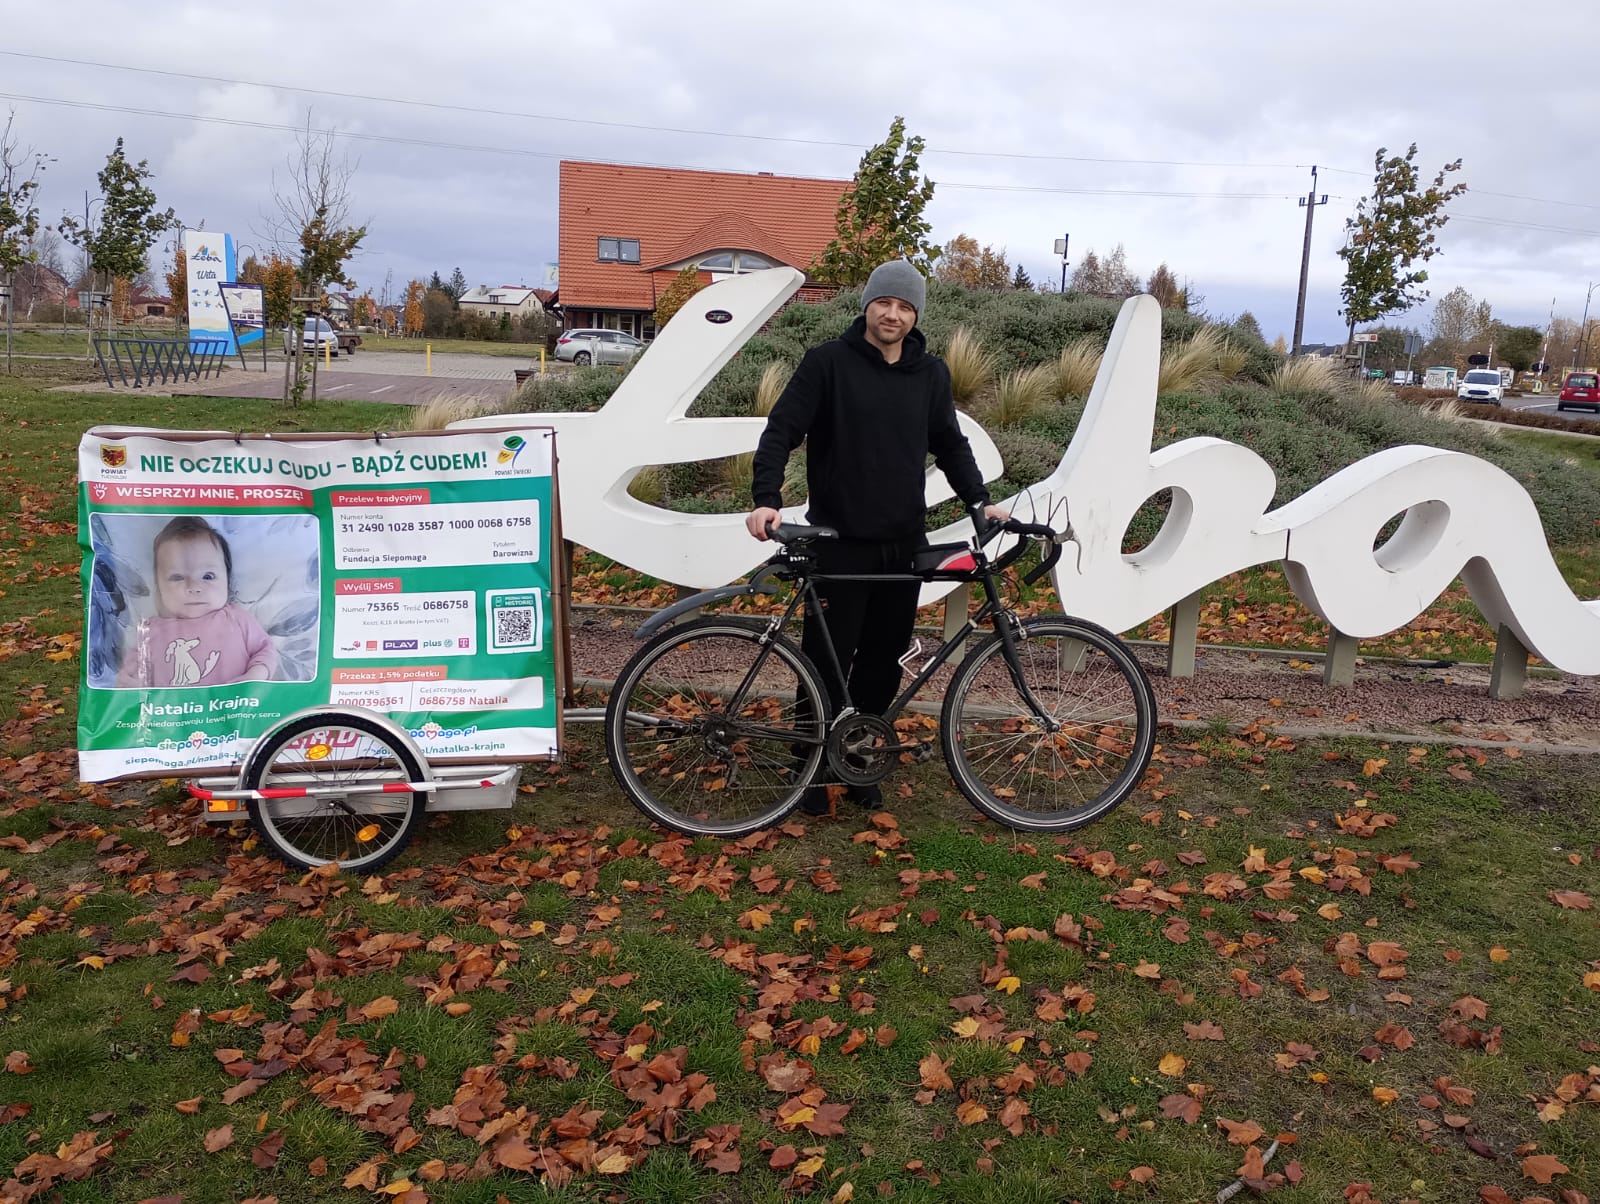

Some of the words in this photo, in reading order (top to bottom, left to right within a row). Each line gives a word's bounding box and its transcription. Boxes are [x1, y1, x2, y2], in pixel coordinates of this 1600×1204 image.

[141, 455, 174, 472] NIE
[179, 456, 273, 474] OCZEKUJ
[278, 459, 332, 480] CUDU
[352, 450, 406, 477] BĄDŹ
[409, 451, 488, 471] CUDEM!
[116, 487, 196, 499] WESPRZYJ
[200, 488, 239, 501] MNIE,
[243, 488, 304, 502] PROSZĘ!
[338, 495, 374, 503] Przelew
[376, 493, 423, 504] tradycyjny
[341, 523, 354, 533] 31
[358, 523, 384, 533] 2490
[387, 522, 415, 532] 1028
[418, 521, 444, 531] 3587
[449, 520, 474, 529] 1000
[477, 518, 503, 528] 0068
[506, 517, 532, 526] 6758
[343, 554, 380, 564] Fundacja
[382, 554, 427, 563] Siepomaga
[492, 550, 534, 558] Darowizna
[343, 582, 371, 592] Wyślij
[373, 582, 394, 591] SMS
[367, 602, 400, 612] 75365
[423, 600, 469, 611] 0686758
[385, 641, 416, 649] PLAY
[423, 640, 442, 649] plus
[340, 672, 376, 680] Przekaż
[403, 670, 440, 678] podatku
[140, 702, 204, 716] Natalia
[208, 695, 260, 712] Krajna
[337, 696, 404, 707] 0000396361
[419, 696, 465, 706] 0686758
[469, 695, 509, 705] Natalia
[147, 717, 204, 728] niedorozwoju
[206, 715, 226, 724] lewej
